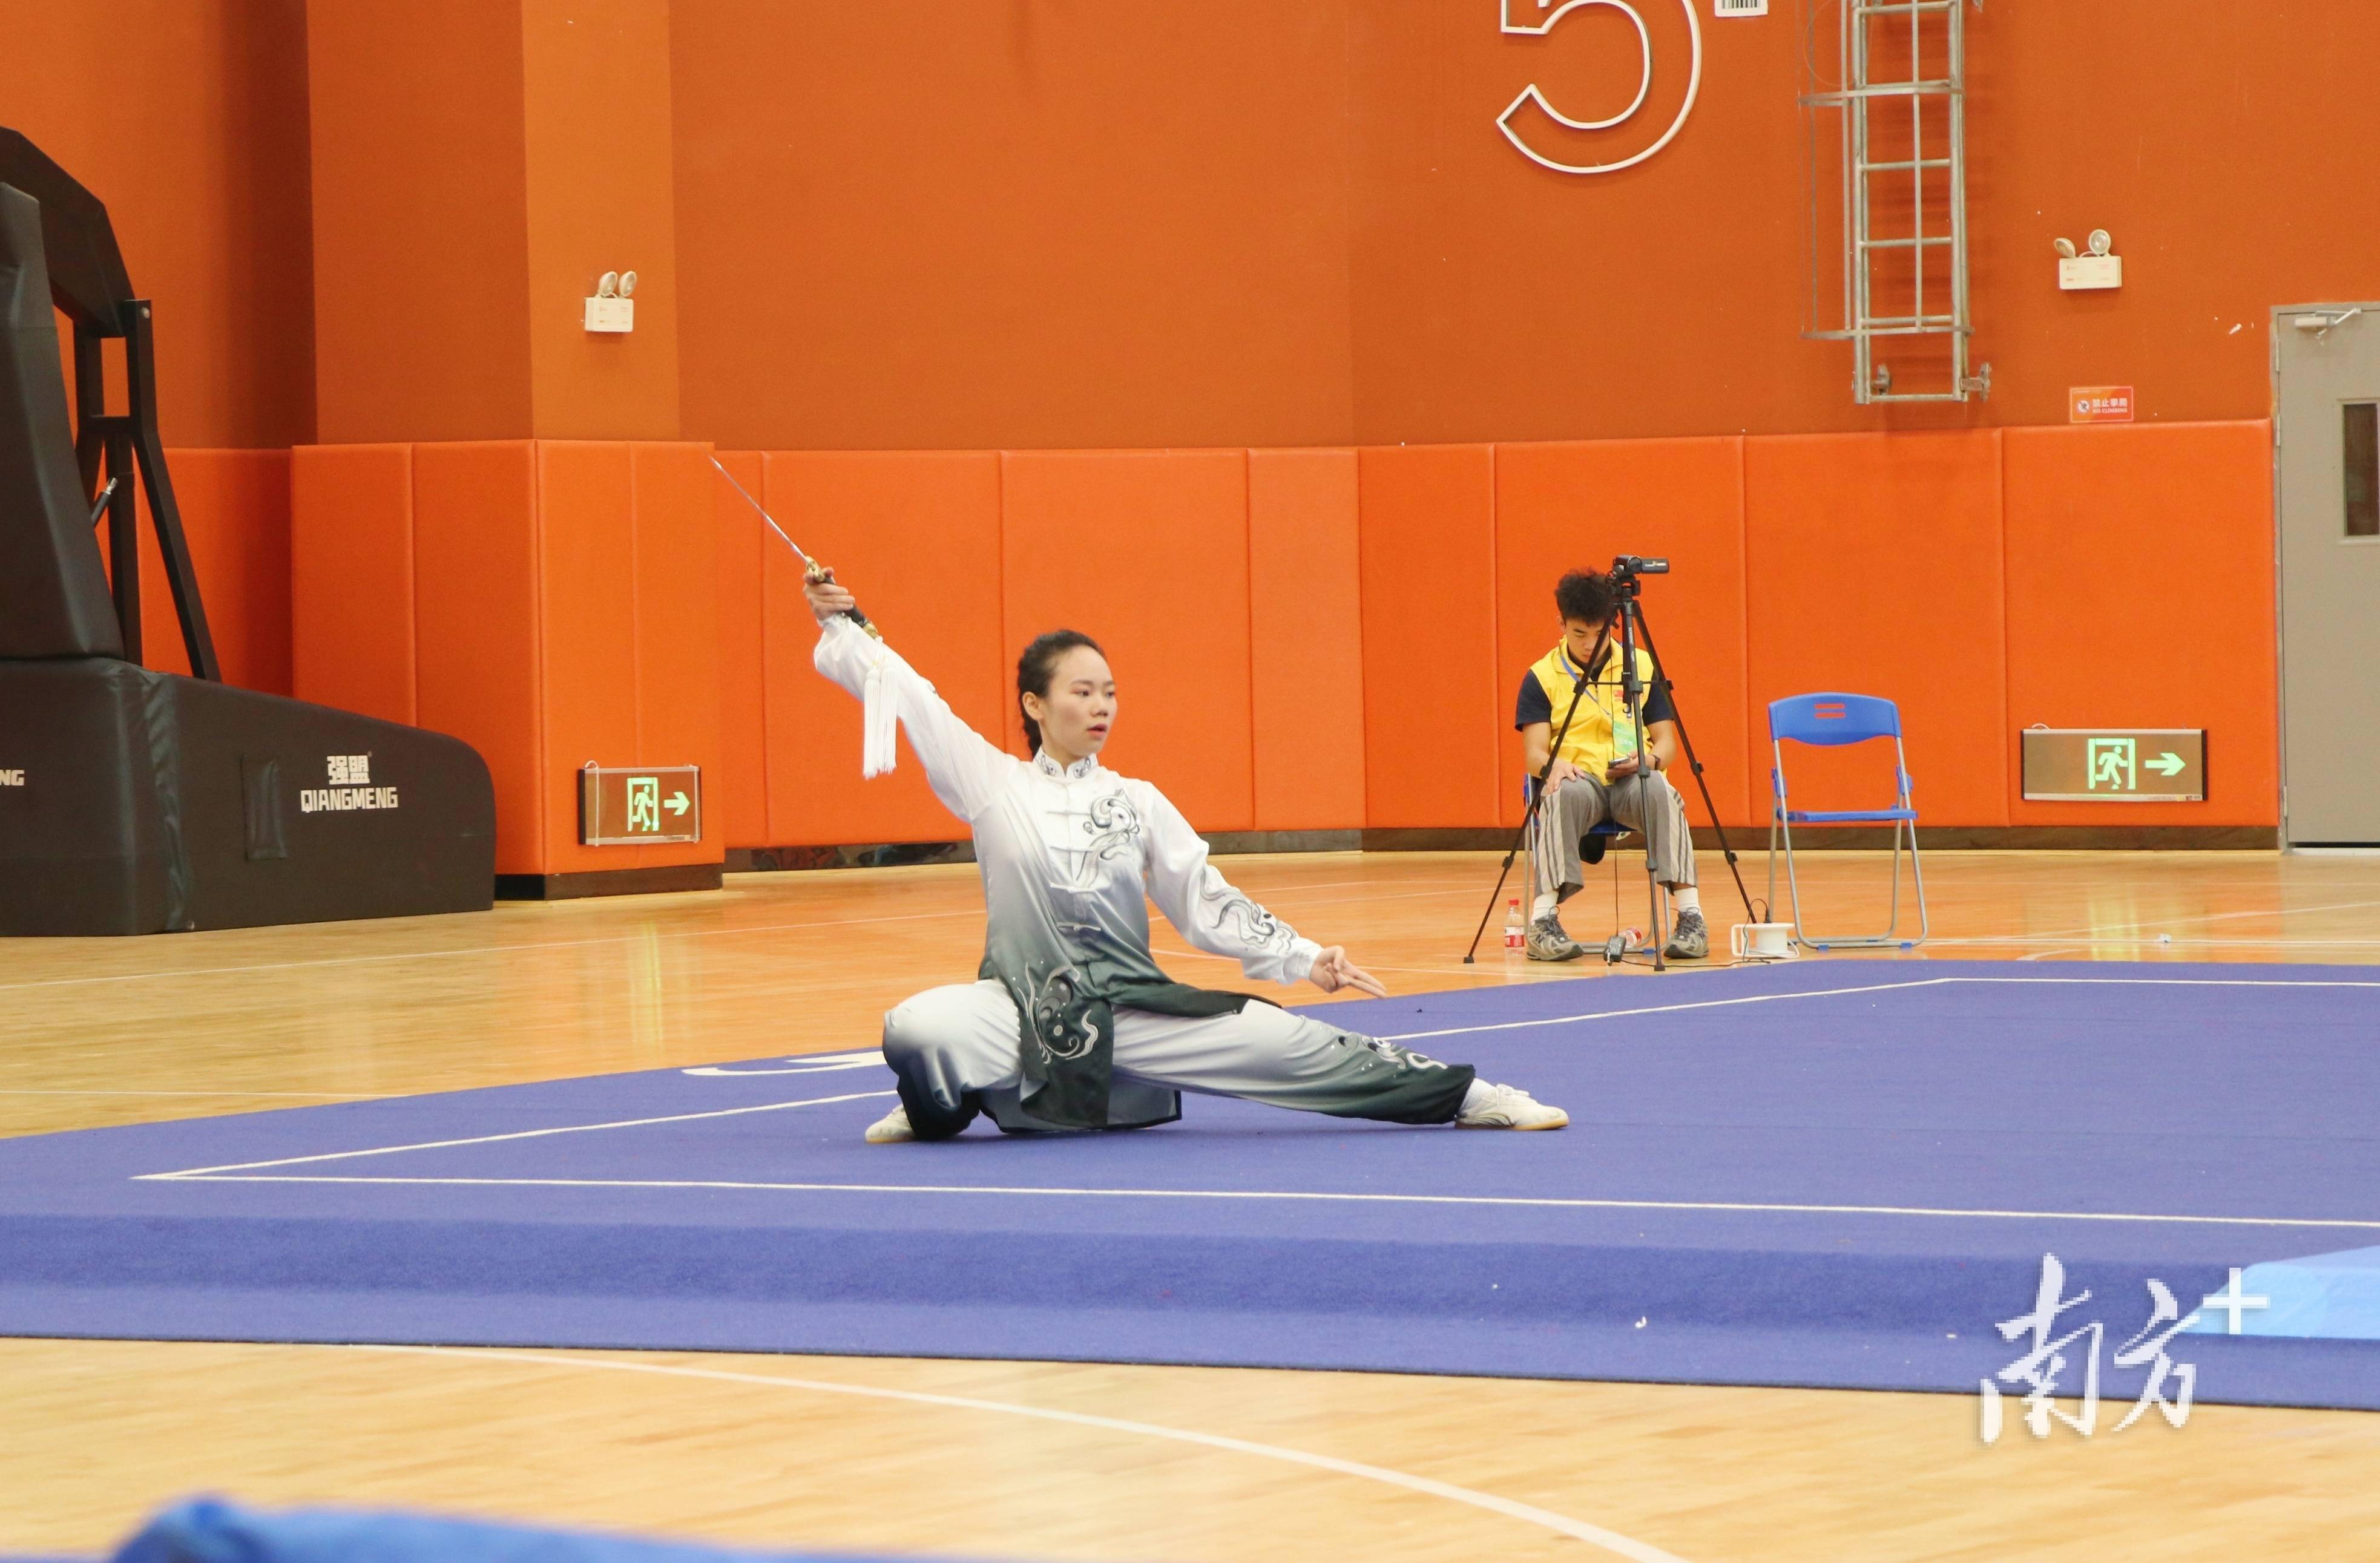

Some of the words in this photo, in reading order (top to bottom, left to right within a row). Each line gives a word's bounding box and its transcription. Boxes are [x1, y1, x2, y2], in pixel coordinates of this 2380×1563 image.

[1496, 0, 1702, 174] 5
[327, 755, 370, 785] 强盟
[301, 787, 398, 813] QIANGMENG
